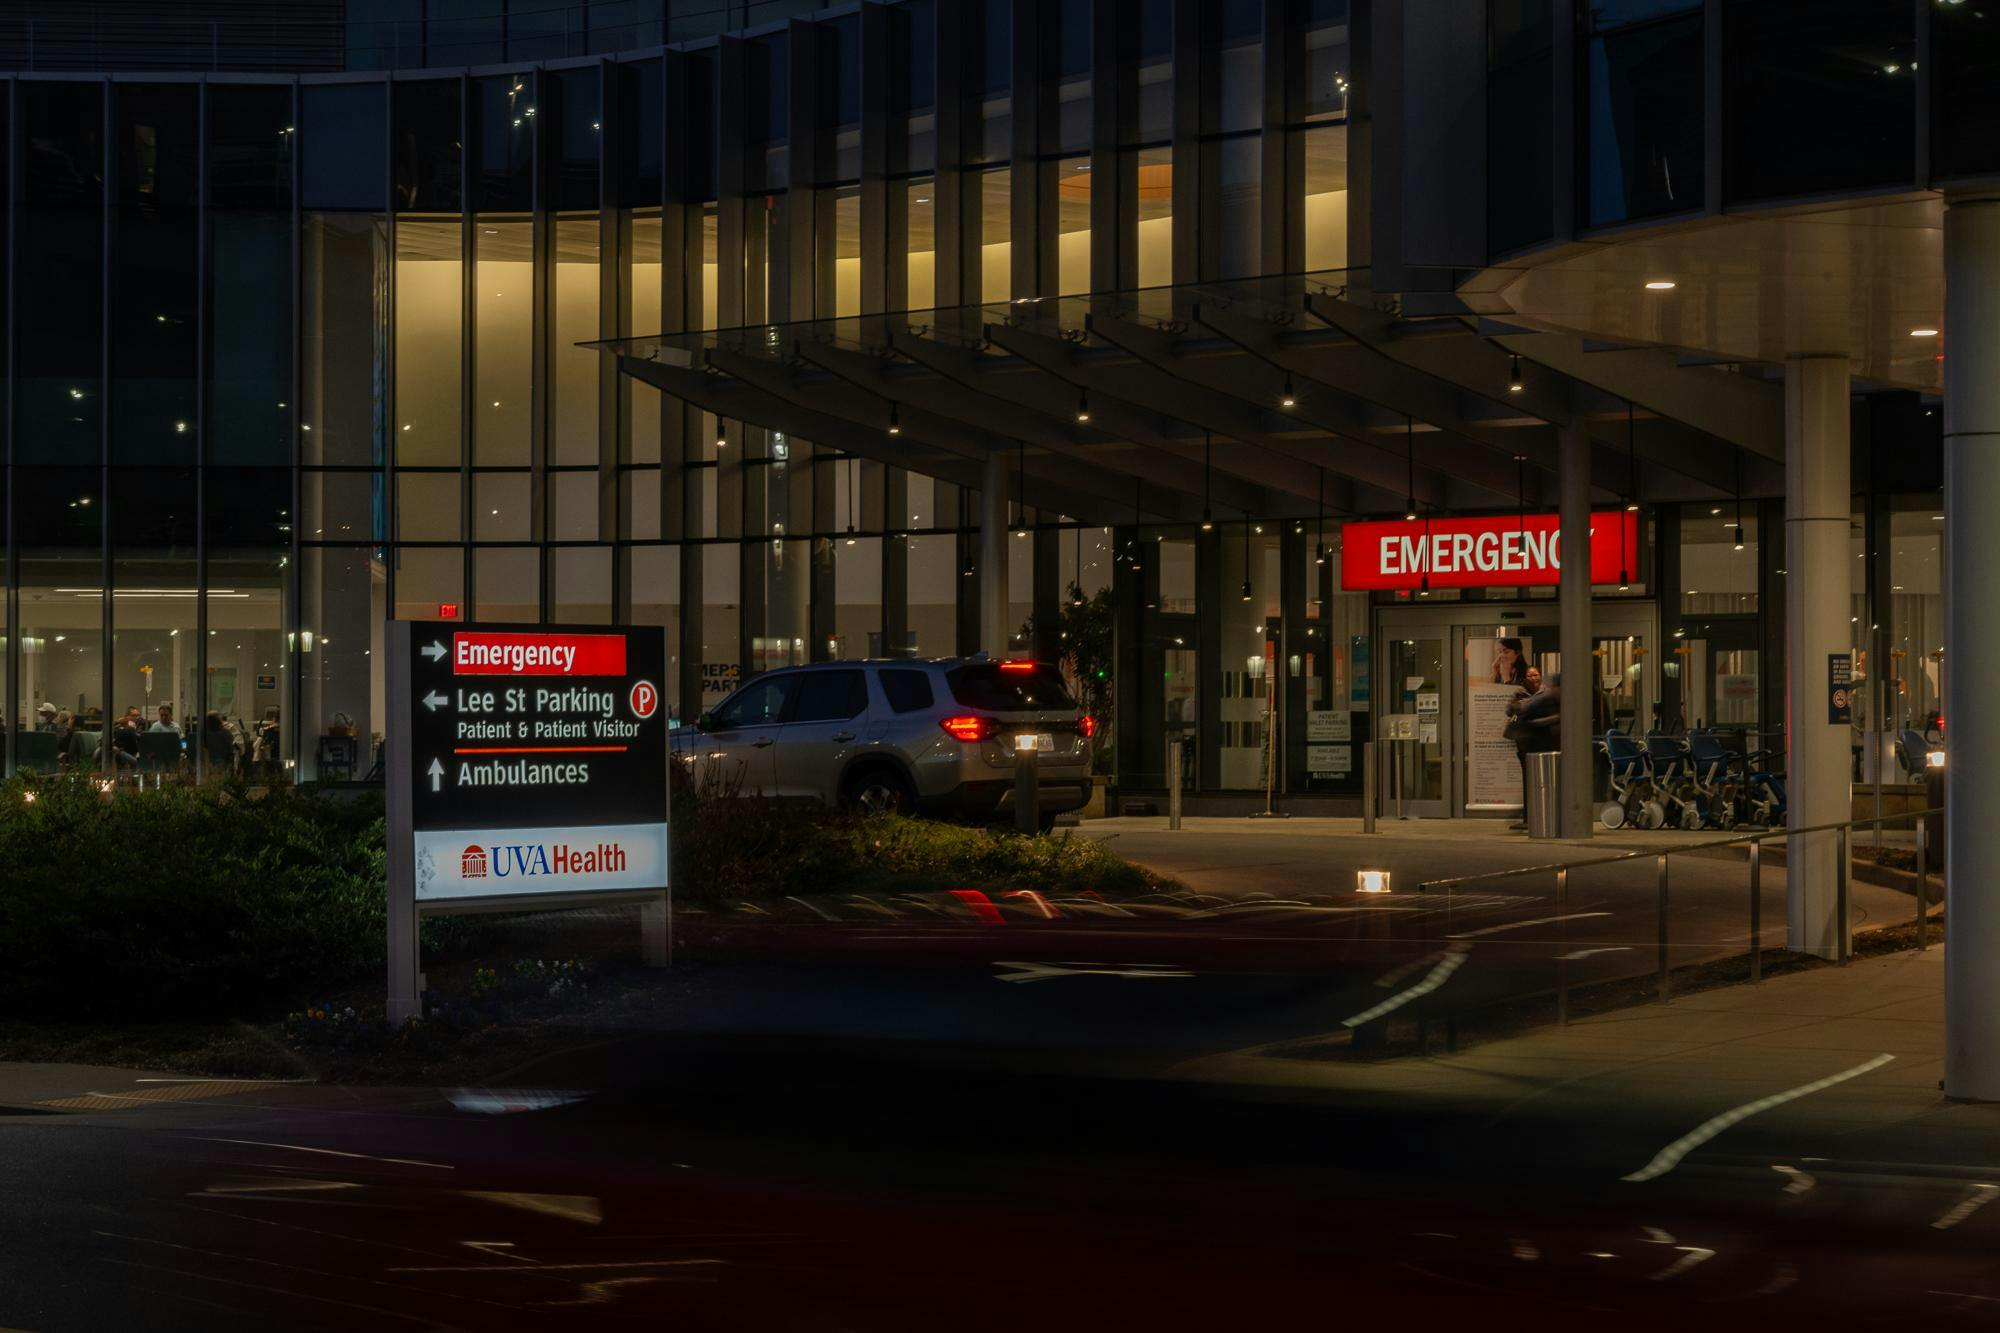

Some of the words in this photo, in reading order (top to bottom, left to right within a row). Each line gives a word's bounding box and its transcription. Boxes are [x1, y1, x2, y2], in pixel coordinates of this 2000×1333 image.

[1379, 528, 1594, 575] EMERGENC
[441, 604, 457, 617] EXIT
[457, 640, 577, 671] Emergency
[457, 688, 495, 712] Lee
[504, 688, 527, 712] St
[536, 687, 615, 718] Parking
[637, 688, 652, 713] P
[457, 721, 512, 739] Patient
[518, 721, 529, 738] &
[535, 720, 588, 738] Patient
[593, 719, 641, 738] Visitor
[457, 760, 590, 787] Ambulances
